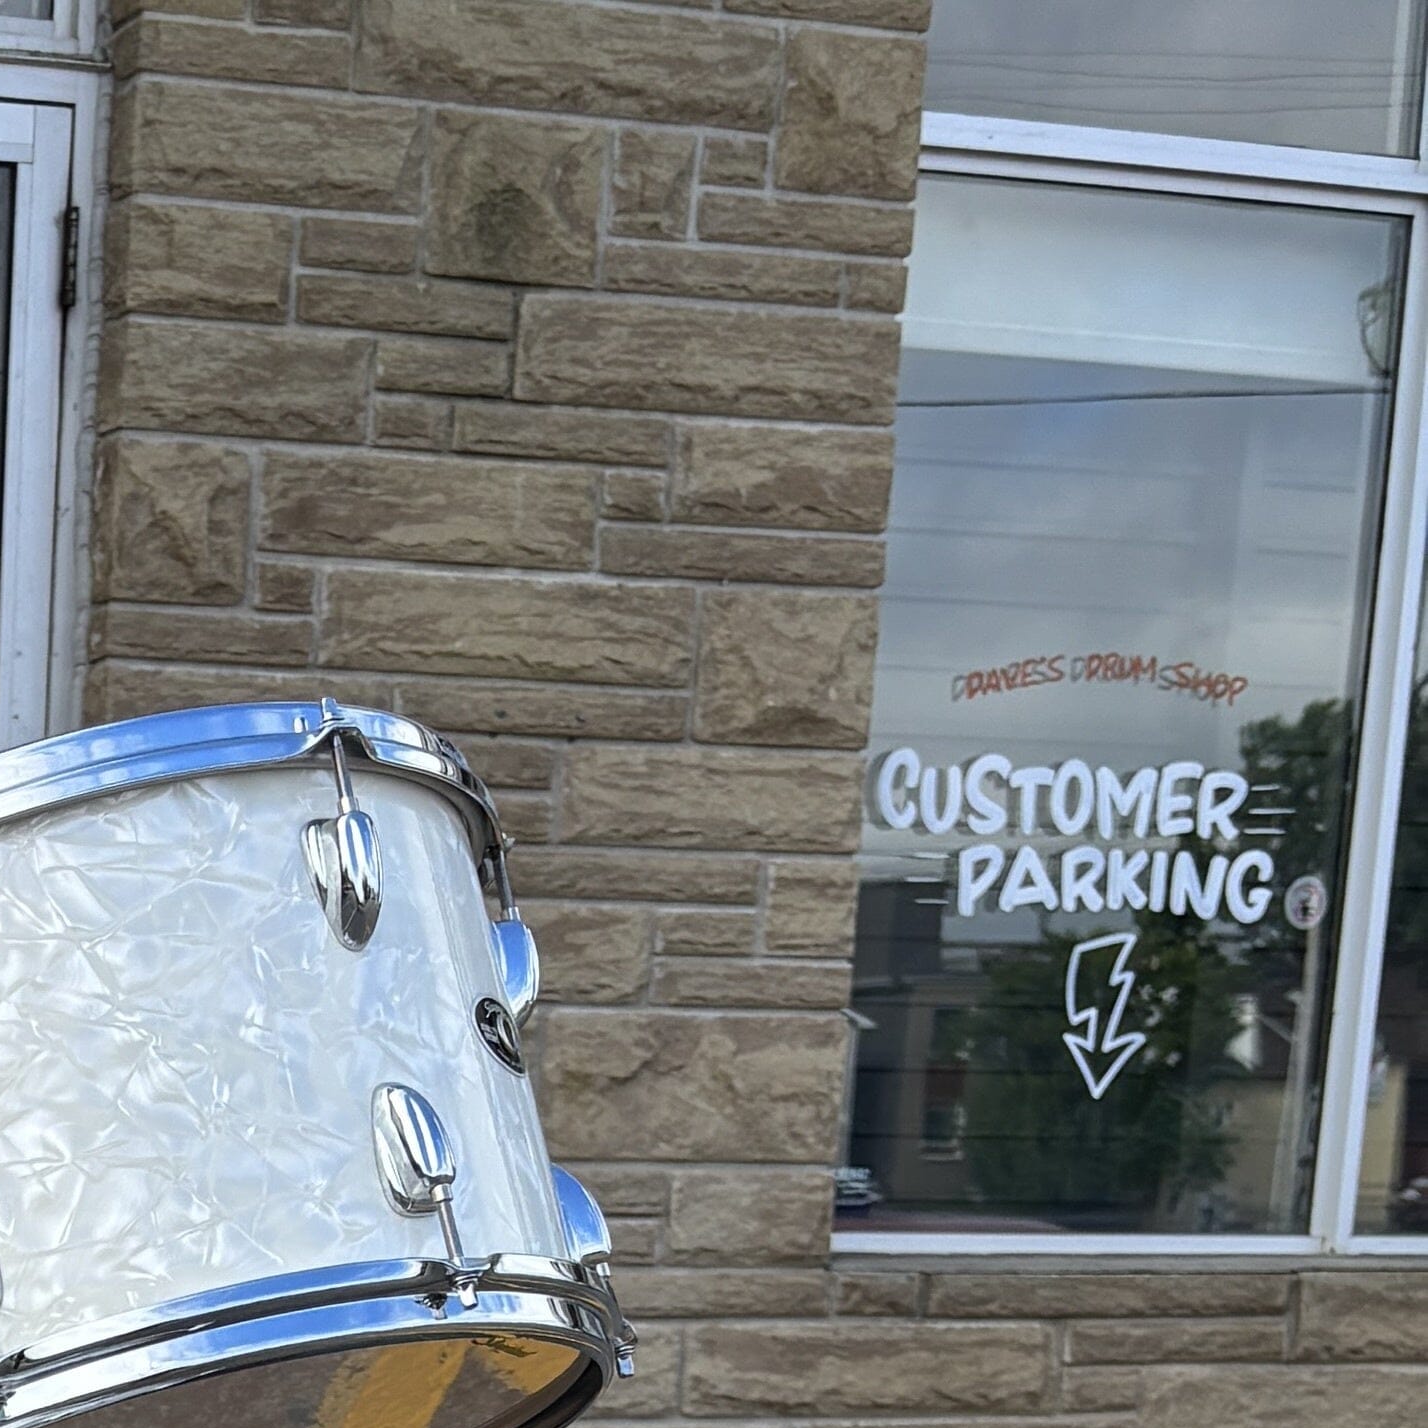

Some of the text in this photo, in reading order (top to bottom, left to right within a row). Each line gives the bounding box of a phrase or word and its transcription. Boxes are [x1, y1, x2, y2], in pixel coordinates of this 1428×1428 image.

[963, 651, 1250, 707] DAVE'S DRUM SHOP
[876, 746, 1250, 843] CUSTOMER
[957, 843, 1276, 925] PARKING
